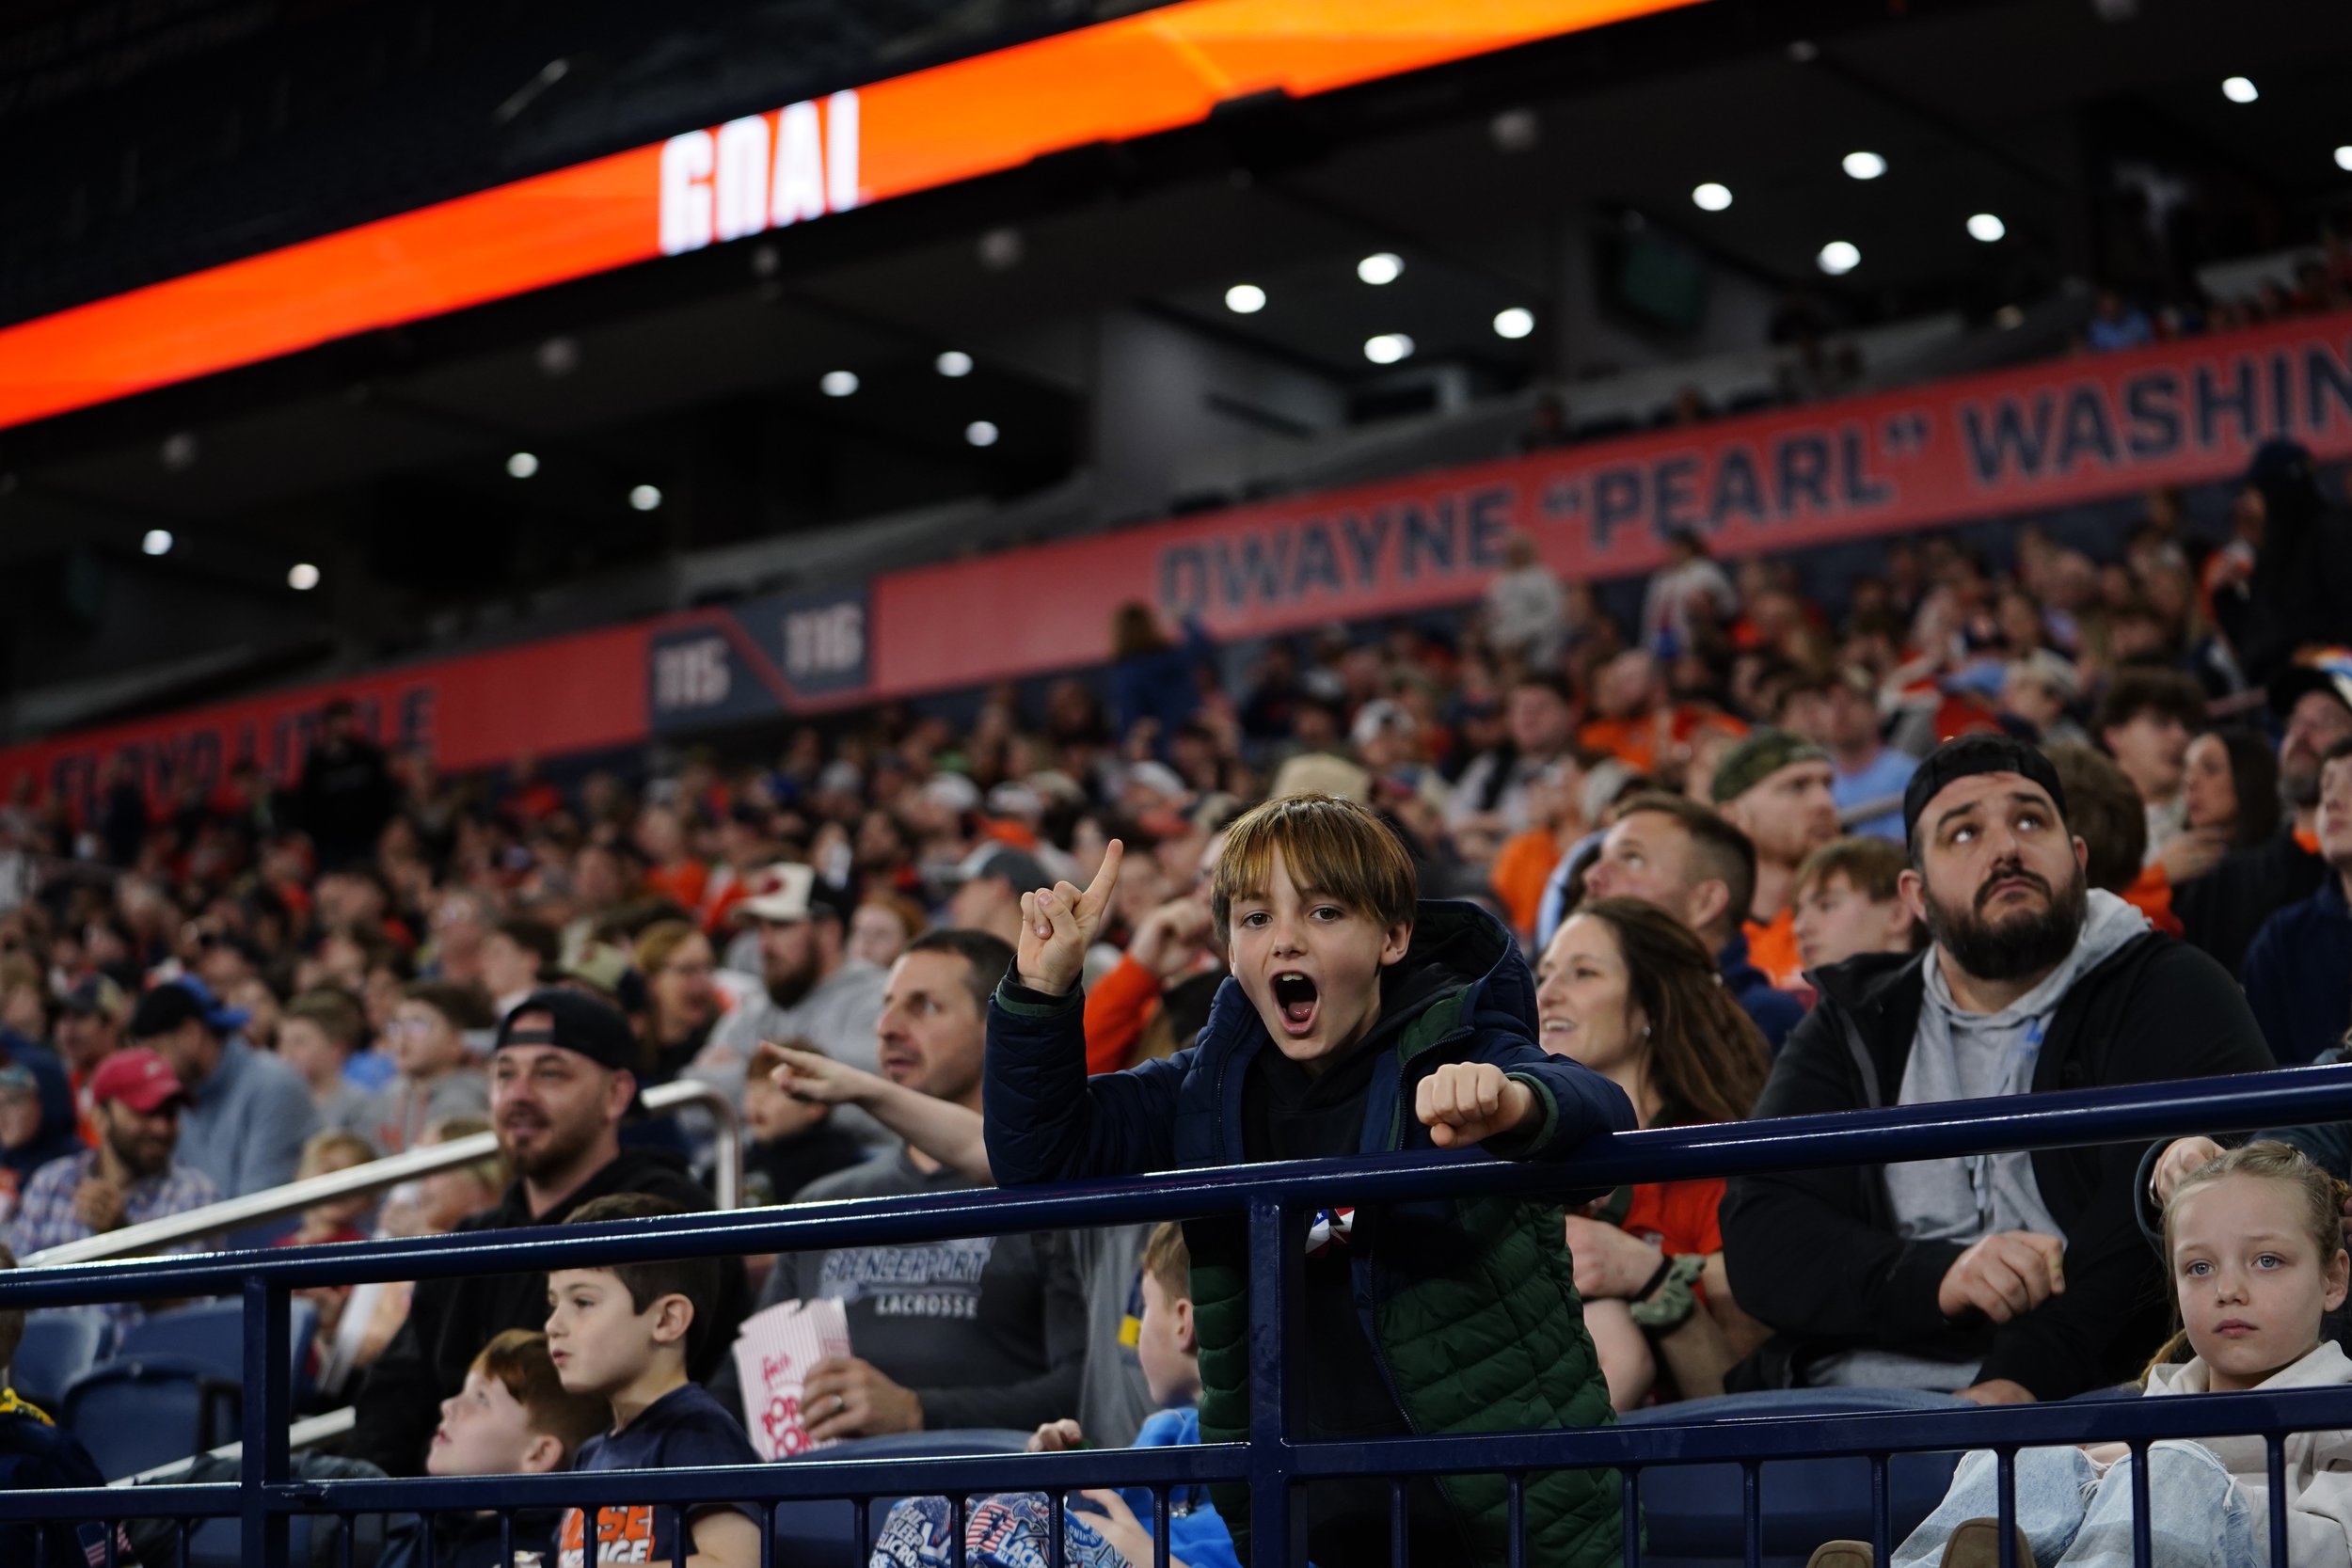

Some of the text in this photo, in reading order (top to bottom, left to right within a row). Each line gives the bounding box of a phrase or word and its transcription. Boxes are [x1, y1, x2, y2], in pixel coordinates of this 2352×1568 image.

[658, 88, 864, 257] GOAL
[1159, 485, 1515, 617] DWAYNE
[655, 638, 731, 709] 115
[784, 599, 866, 675] 116
[875, 1293, 978, 1319] LACROSSE
